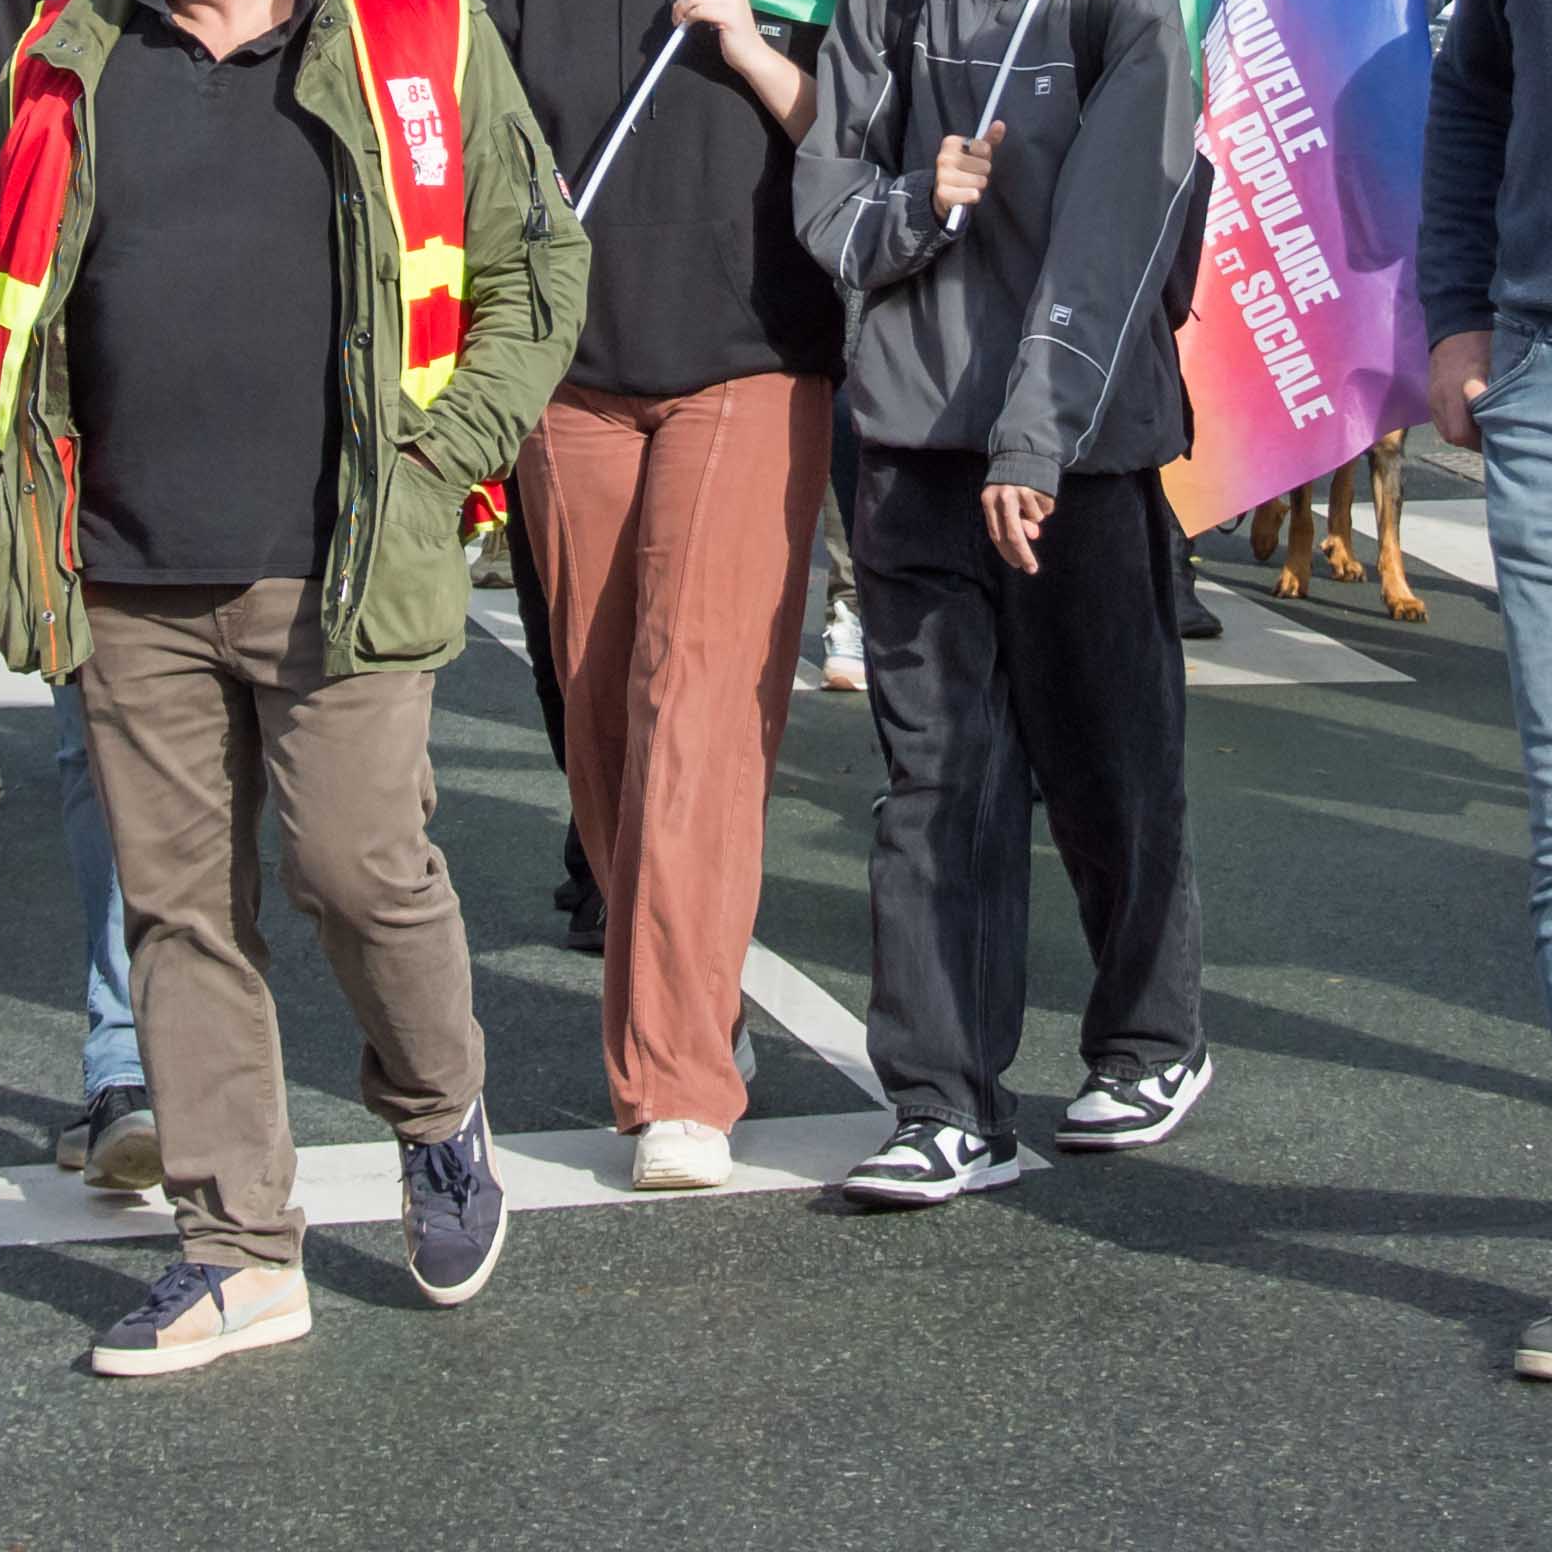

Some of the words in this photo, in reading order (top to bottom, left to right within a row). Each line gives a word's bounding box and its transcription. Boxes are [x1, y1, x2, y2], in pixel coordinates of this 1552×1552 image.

[1219, 111, 1341, 315] POPULAIRE
[1214, 247, 1245, 275] ET
[1231, 269, 1335, 430] SOCIALE
